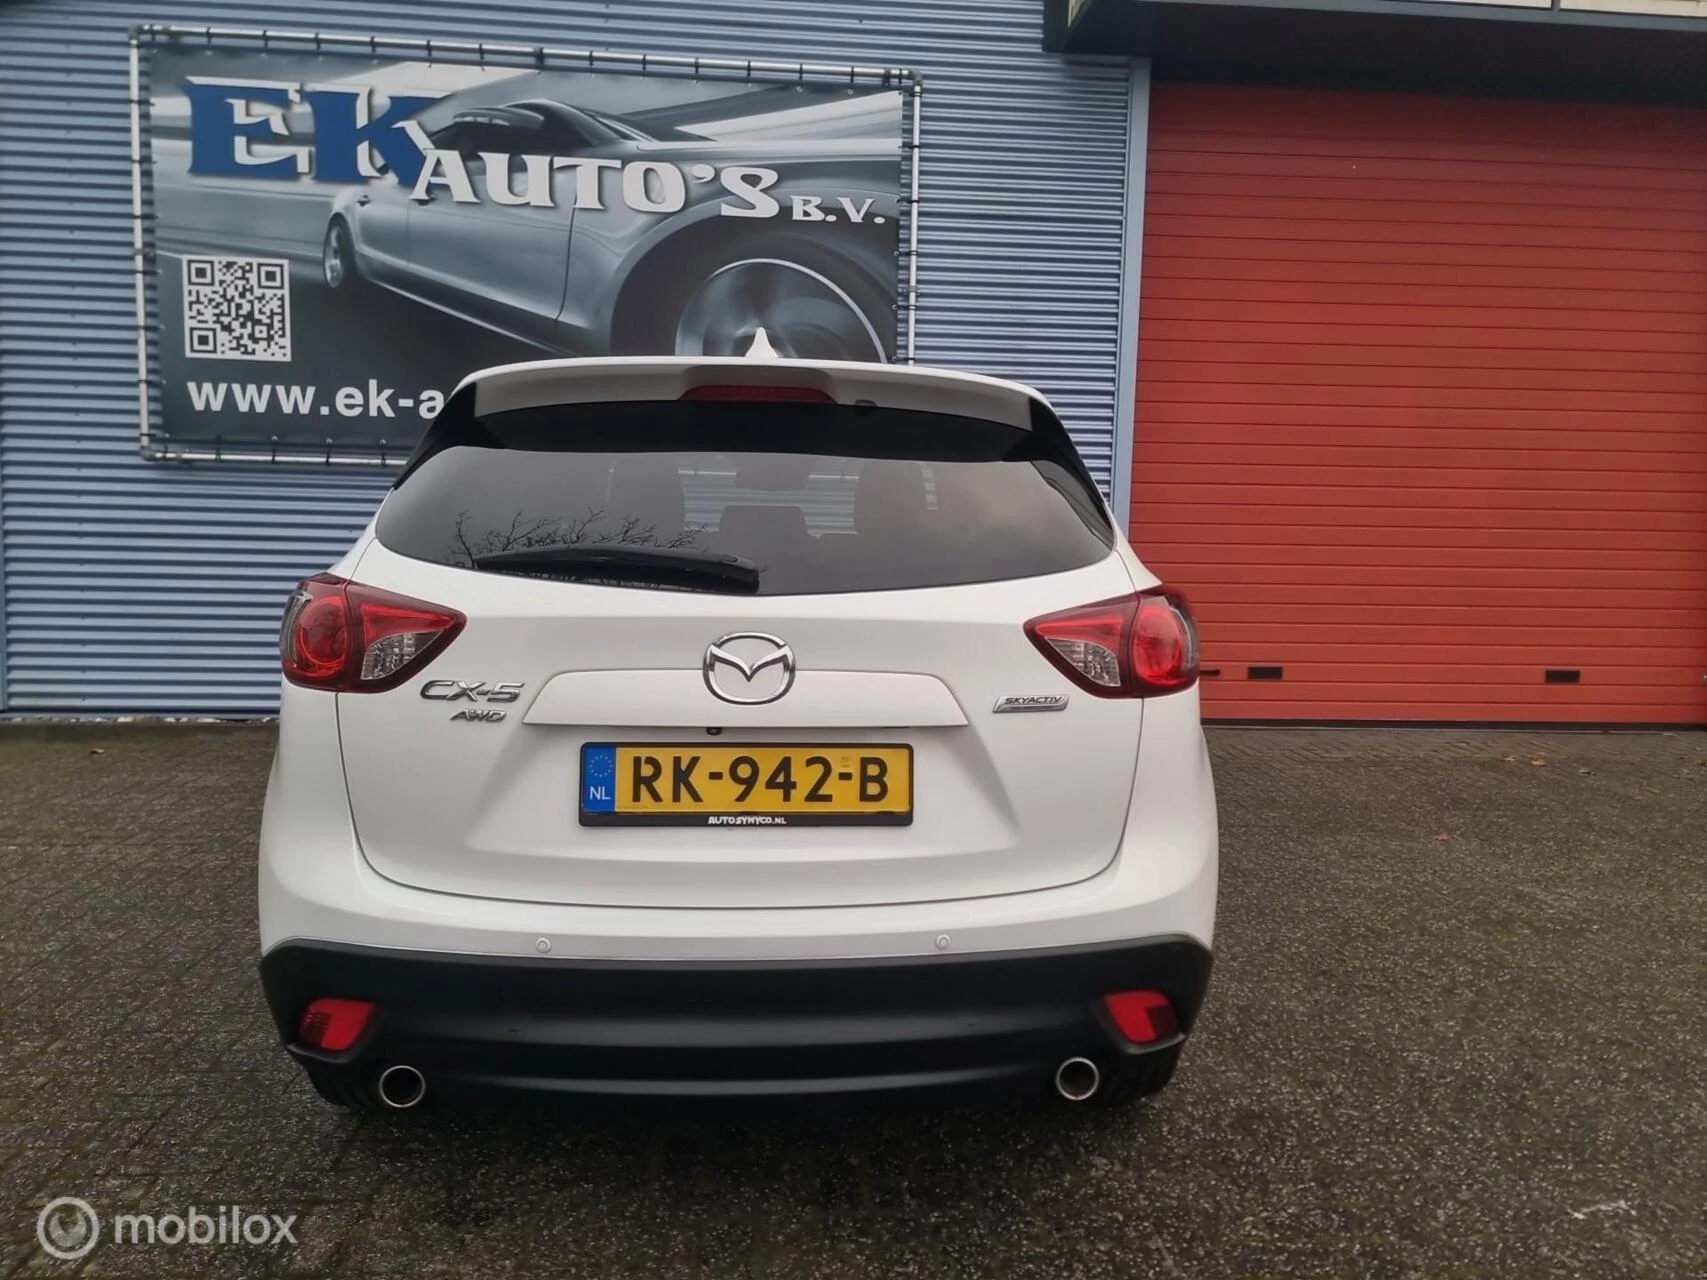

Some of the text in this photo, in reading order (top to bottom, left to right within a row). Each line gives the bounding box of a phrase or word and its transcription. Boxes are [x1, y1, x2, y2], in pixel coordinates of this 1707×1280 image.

[183, 76, 453, 188] EK
[790, 195, 886, 224] B.V.
[420, 680, 525, 703] CX-5
[1003, 696, 1063, 705] SKYACTIV
[449, 709, 507, 723] AWD
[589, 785, 611, 801] NL
[631, 755, 890, 803] RK-942-B
